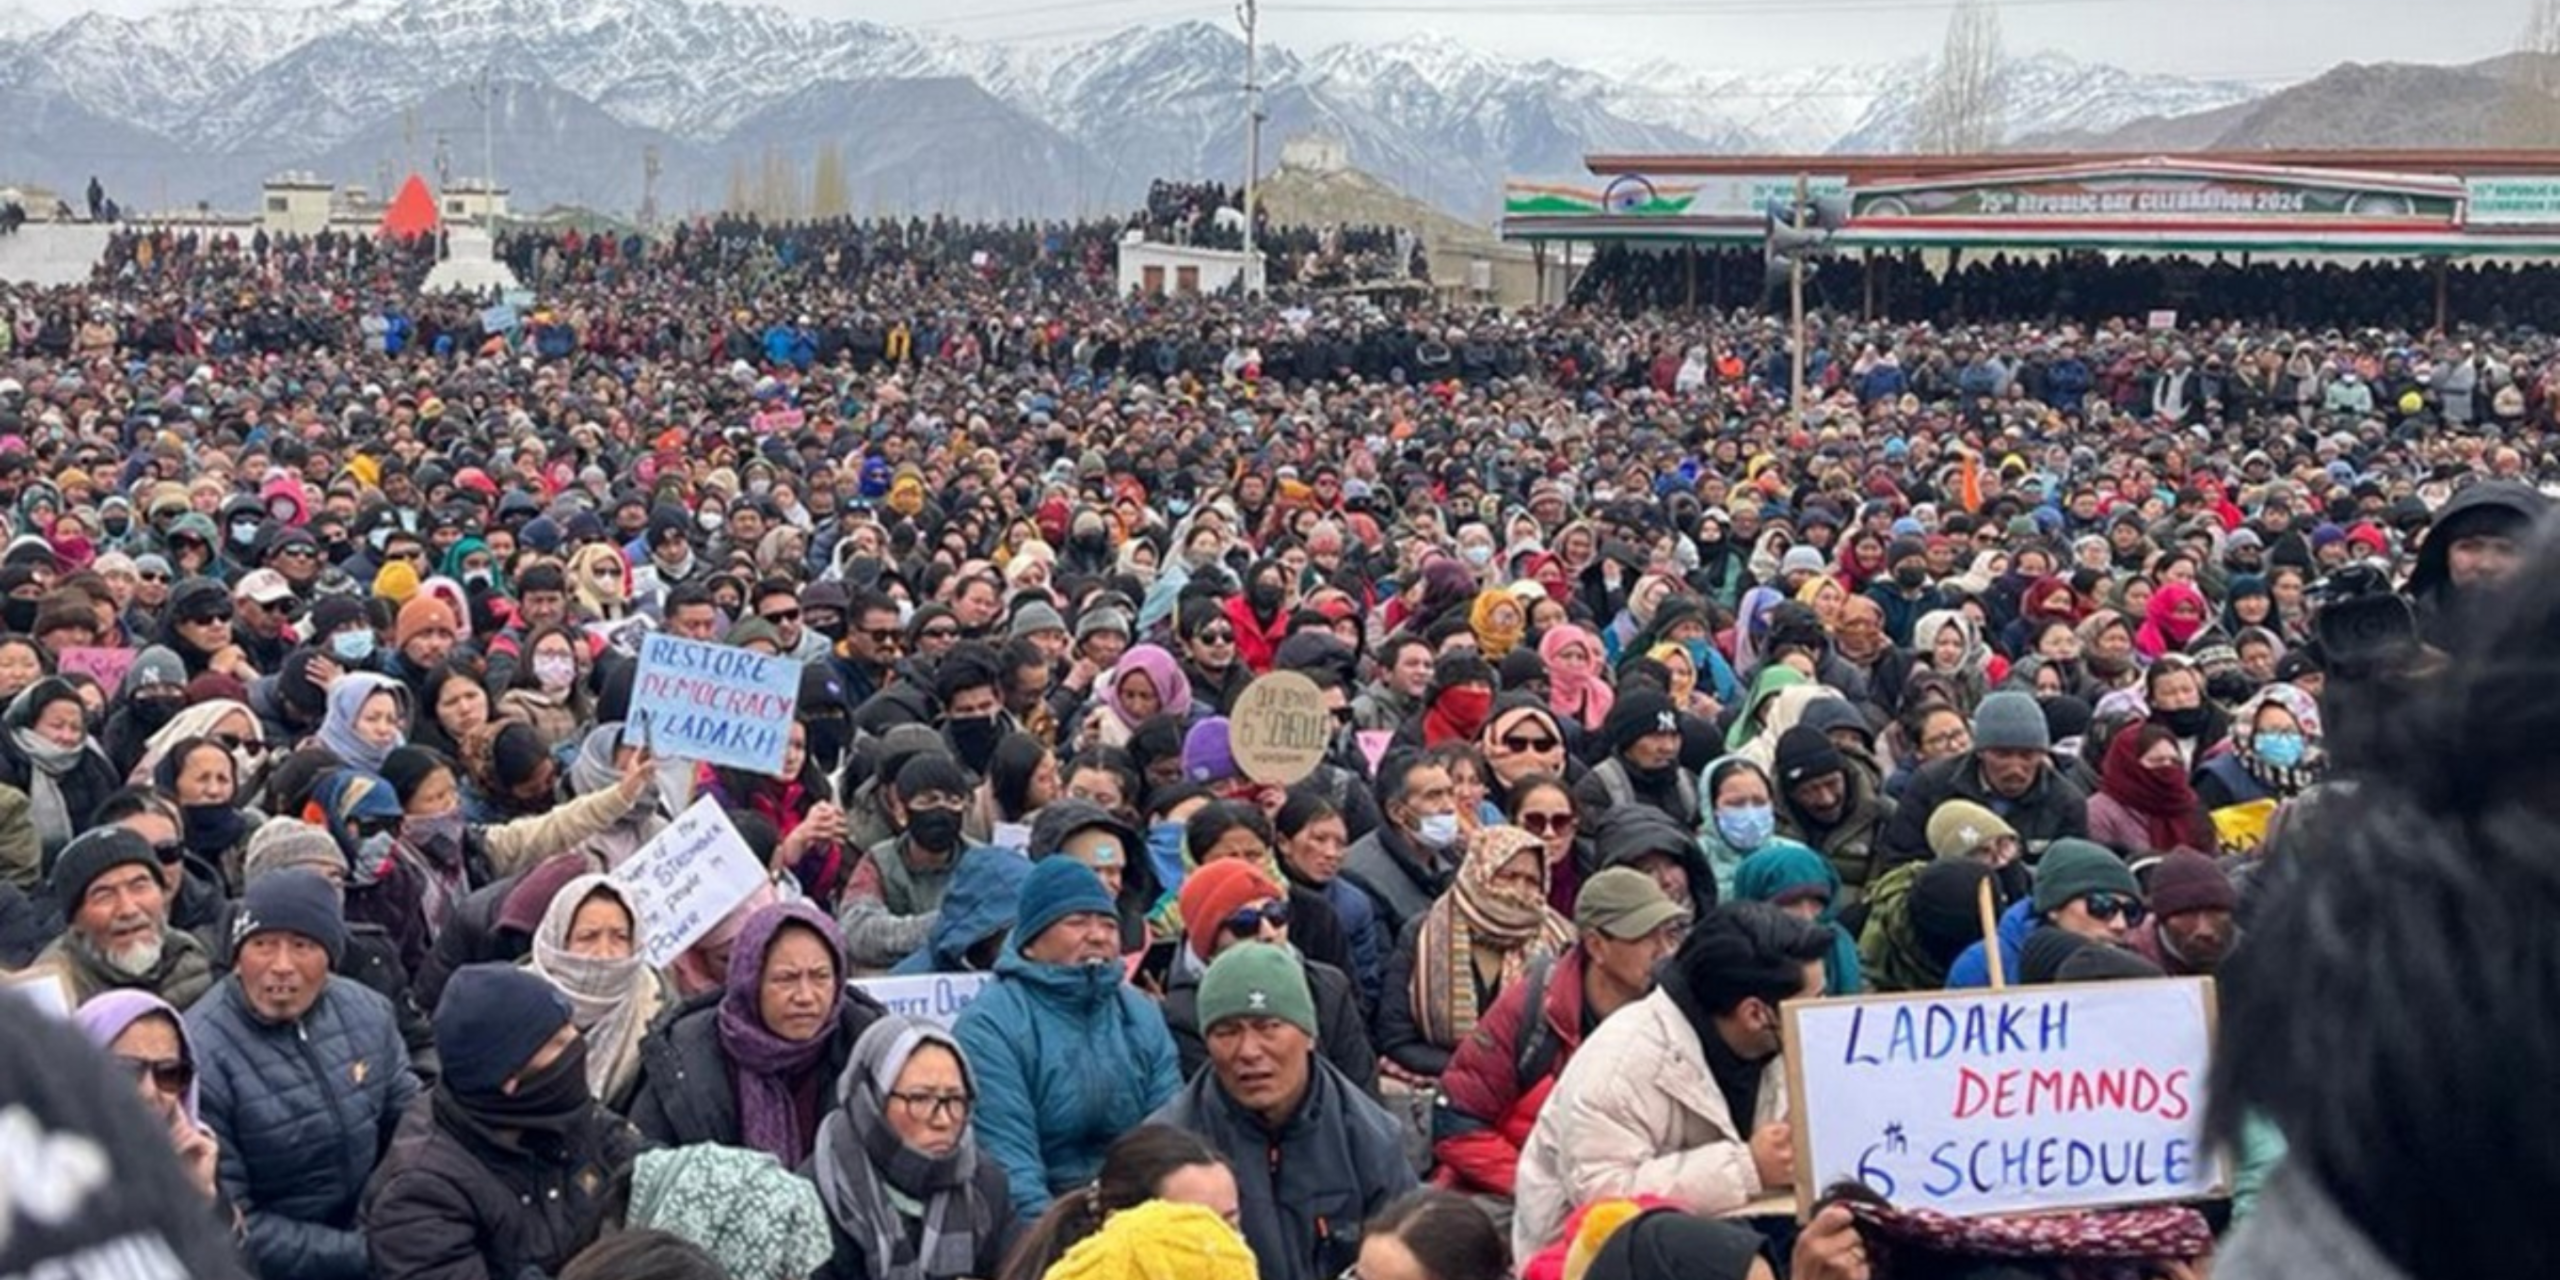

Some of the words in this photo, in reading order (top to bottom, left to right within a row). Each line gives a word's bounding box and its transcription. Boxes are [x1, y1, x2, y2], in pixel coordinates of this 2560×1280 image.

[2016, 193, 2097, 213] REPUBLIC
[2101, 192, 2133, 211] DAY
[2138, 191, 2252, 211] CELEBRATION
[2256, 191, 2303, 211] 2024
[650, 638, 768, 683] RESTORE
[639, 672, 794, 721] DEMOCRACY
[662, 713, 779, 757] LADAKH
[1844, 1000, 2070, 1067] LADAKH
[1951, 1065, 2191, 1122] DEMANDS
[1921, 1136, 2193, 1198] SCHEDULE
